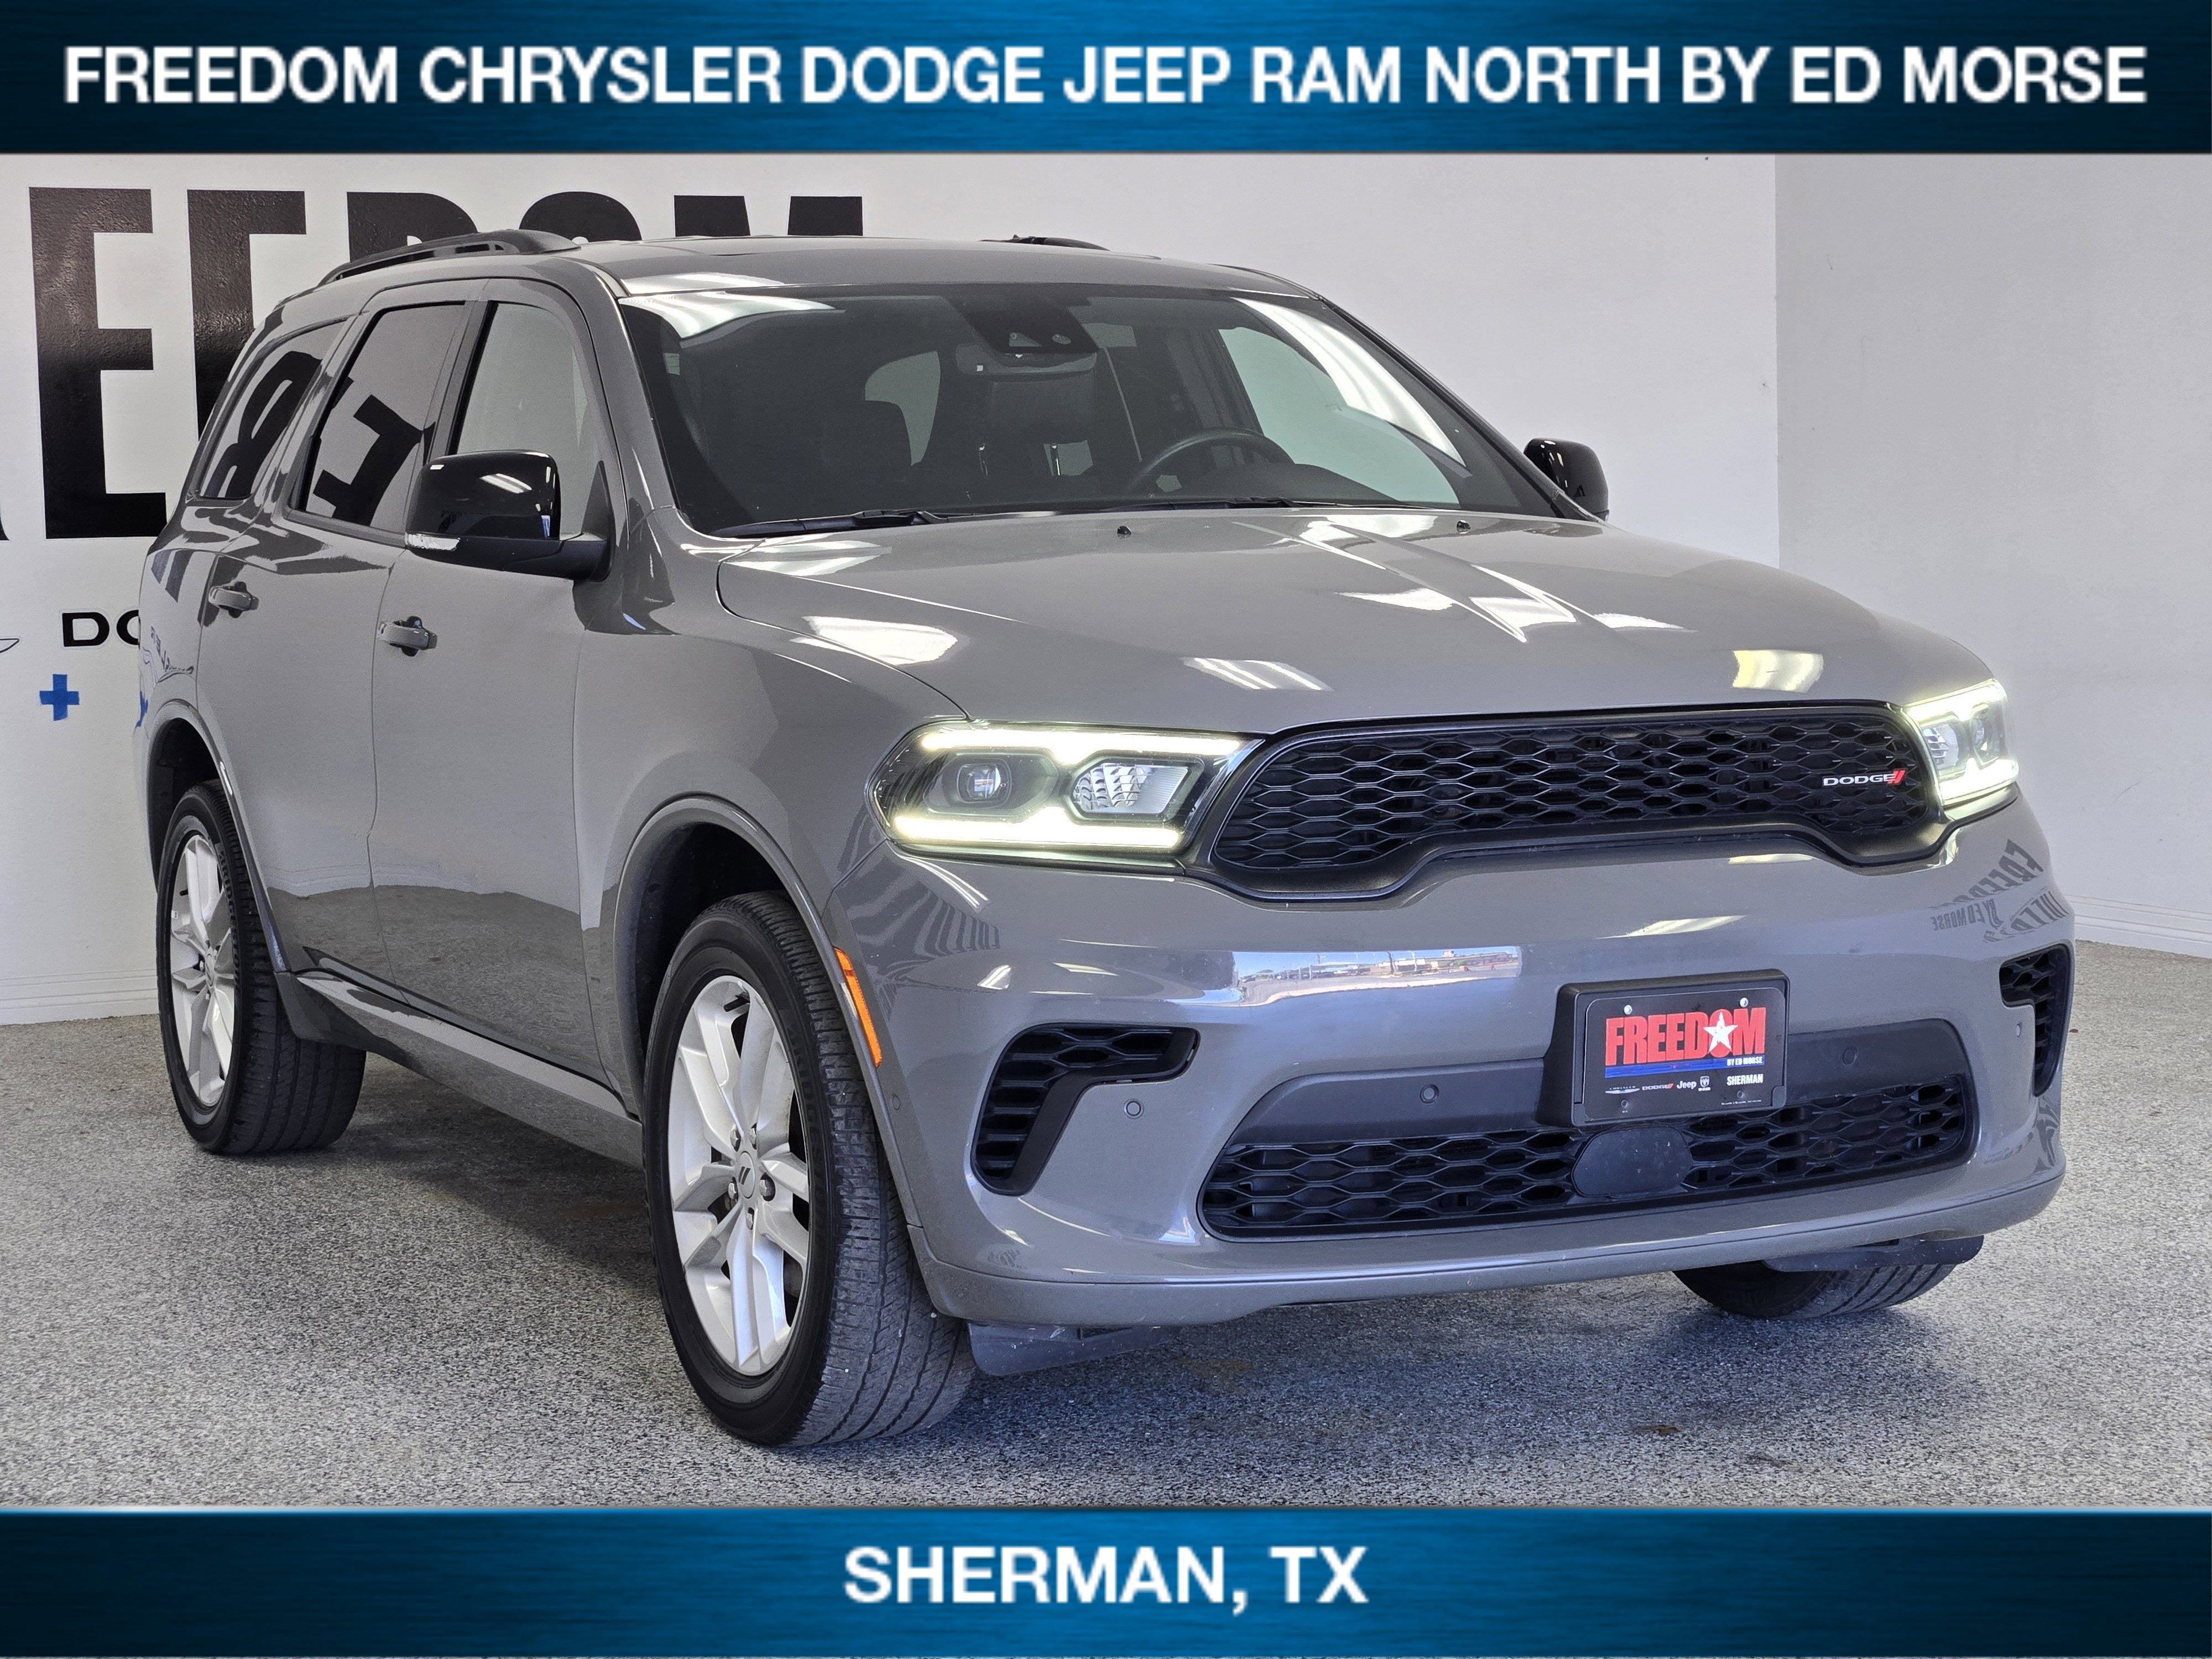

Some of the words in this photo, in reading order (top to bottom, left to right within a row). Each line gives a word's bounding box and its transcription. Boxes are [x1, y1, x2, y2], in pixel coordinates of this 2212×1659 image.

[1823, 773, 1897, 786] DODGE
[1605, 1006, 1766, 1066] FREEDOM
[1676, 1081, 1697, 1091] Jeep
[1726, 1074, 1764, 1086] SHERMAN
